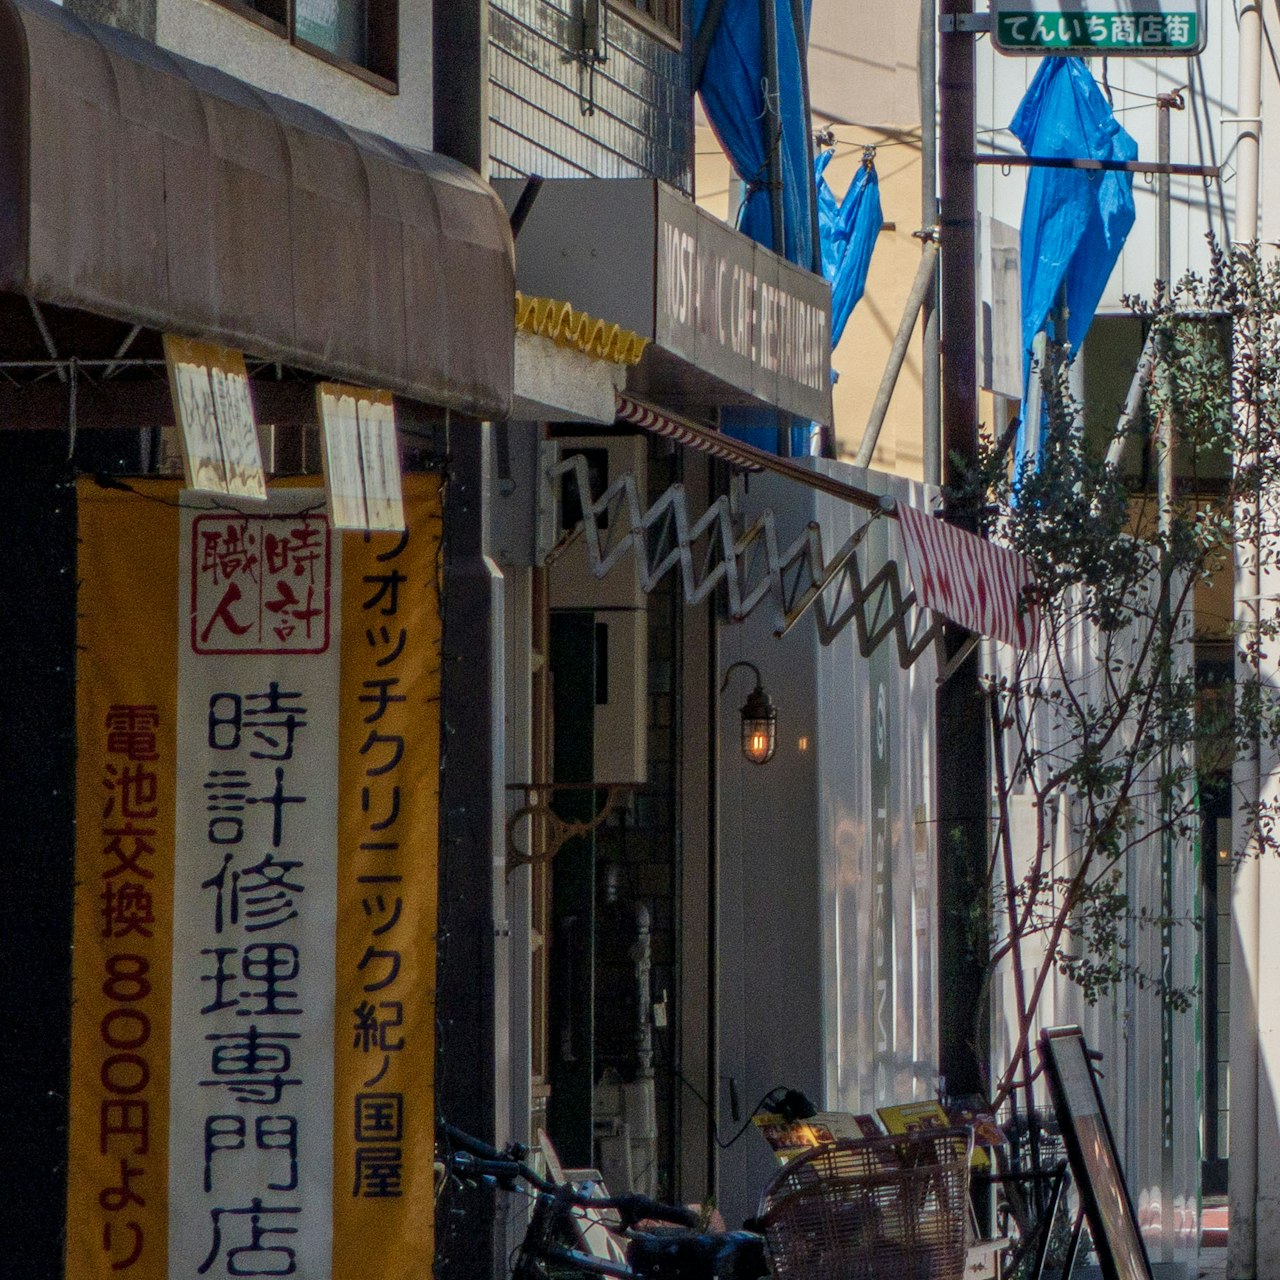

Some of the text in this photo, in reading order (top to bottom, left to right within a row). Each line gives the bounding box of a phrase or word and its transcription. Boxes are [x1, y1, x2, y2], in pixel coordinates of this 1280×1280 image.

[1001, 12, 1191, 45] てんいち商店街
[731, 264, 759, 362] CAFE
[761, 283, 826, 392] RESTAURANT
[199, 524, 259, 643] 職人
[264, 524, 323, 643] 時計
[98, 704, 160, 1271] 電池交換800円より
[197, 681, 307, 1276] 時計修理専門店
